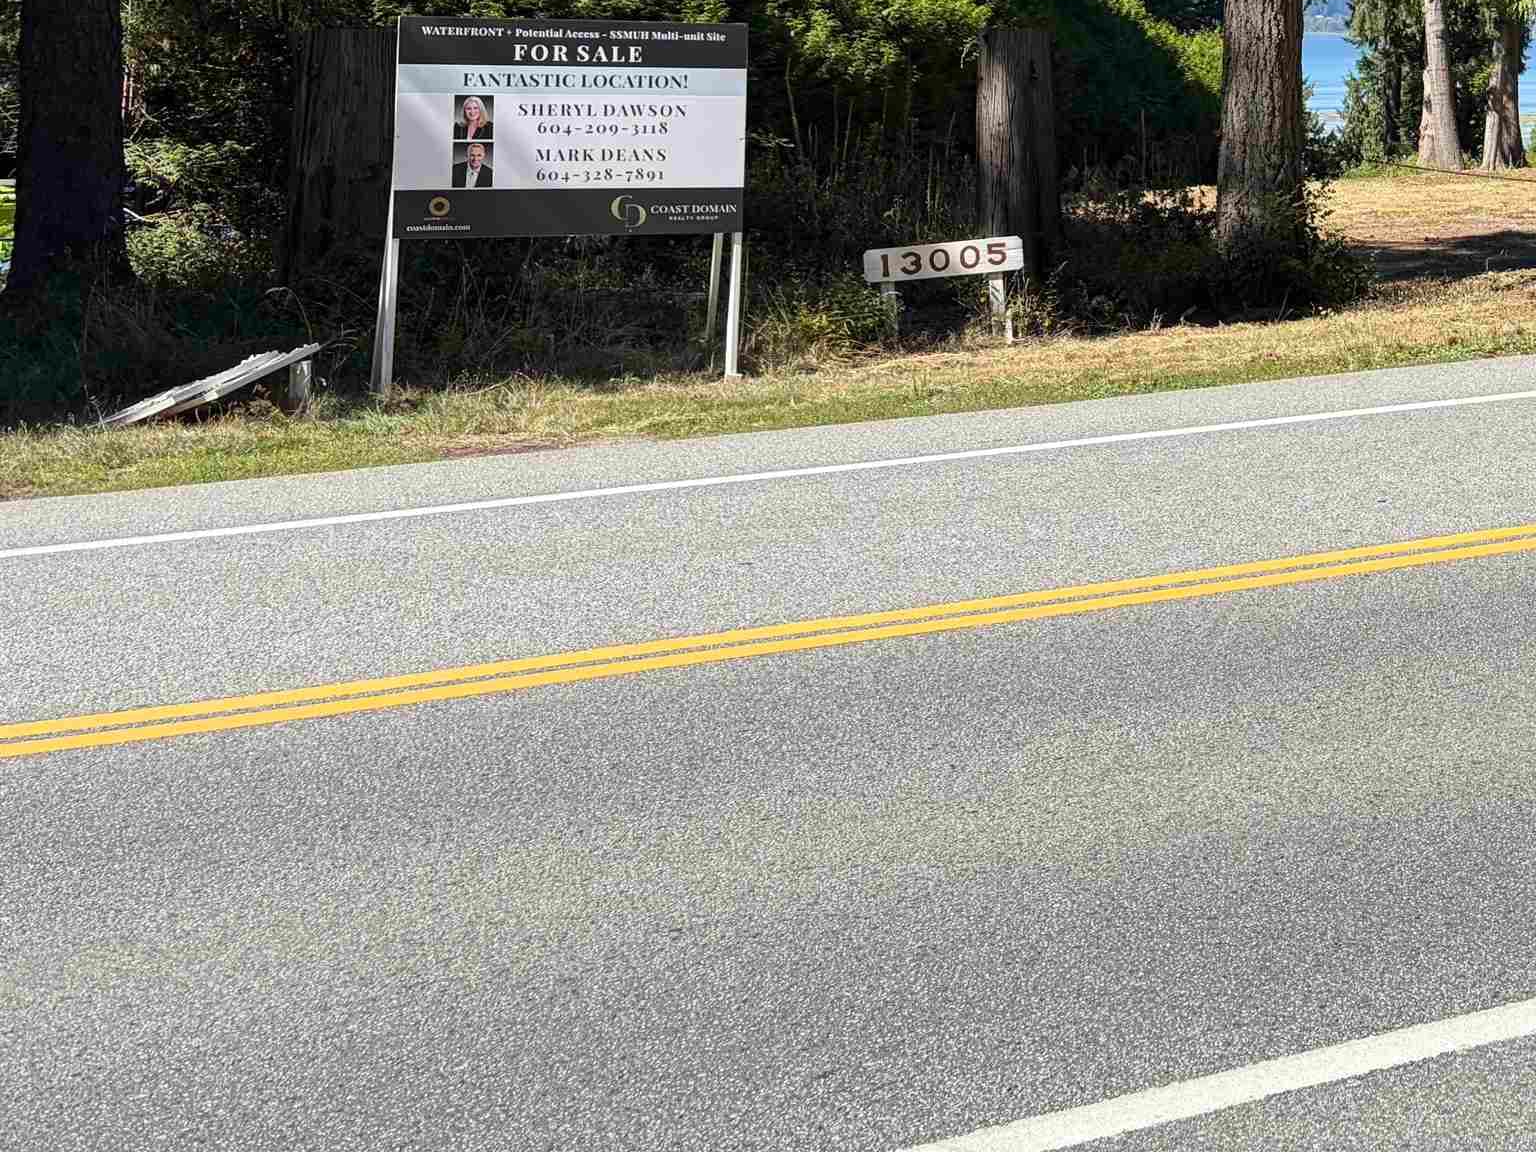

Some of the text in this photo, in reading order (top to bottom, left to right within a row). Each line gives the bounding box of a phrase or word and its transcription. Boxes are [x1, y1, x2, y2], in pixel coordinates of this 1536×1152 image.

[422, 26, 505, 37] WATERFRONT
[515, 28, 563, 39] Potential
[564, 29, 600, 39] Access
[609, 30, 649, 40] SSMUH
[651, 31, 705, 41] Multi-unit
[706, 32, 727, 42] Site
[513, 44, 643, 63] FOR SALE
[463, 72, 688, 89] FANTASTIC LOCATION!
[518, 103, 688, 118] SHERYL DAWSON
[537, 121, 668, 136] 604-209-3118
[536, 148, 667, 162] MARK DEANS
[536, 167, 664, 183] 604-328-7891
[650, 204, 737, 214] COAST DOMAIN
[880, 242, 1008, 278] 13005
